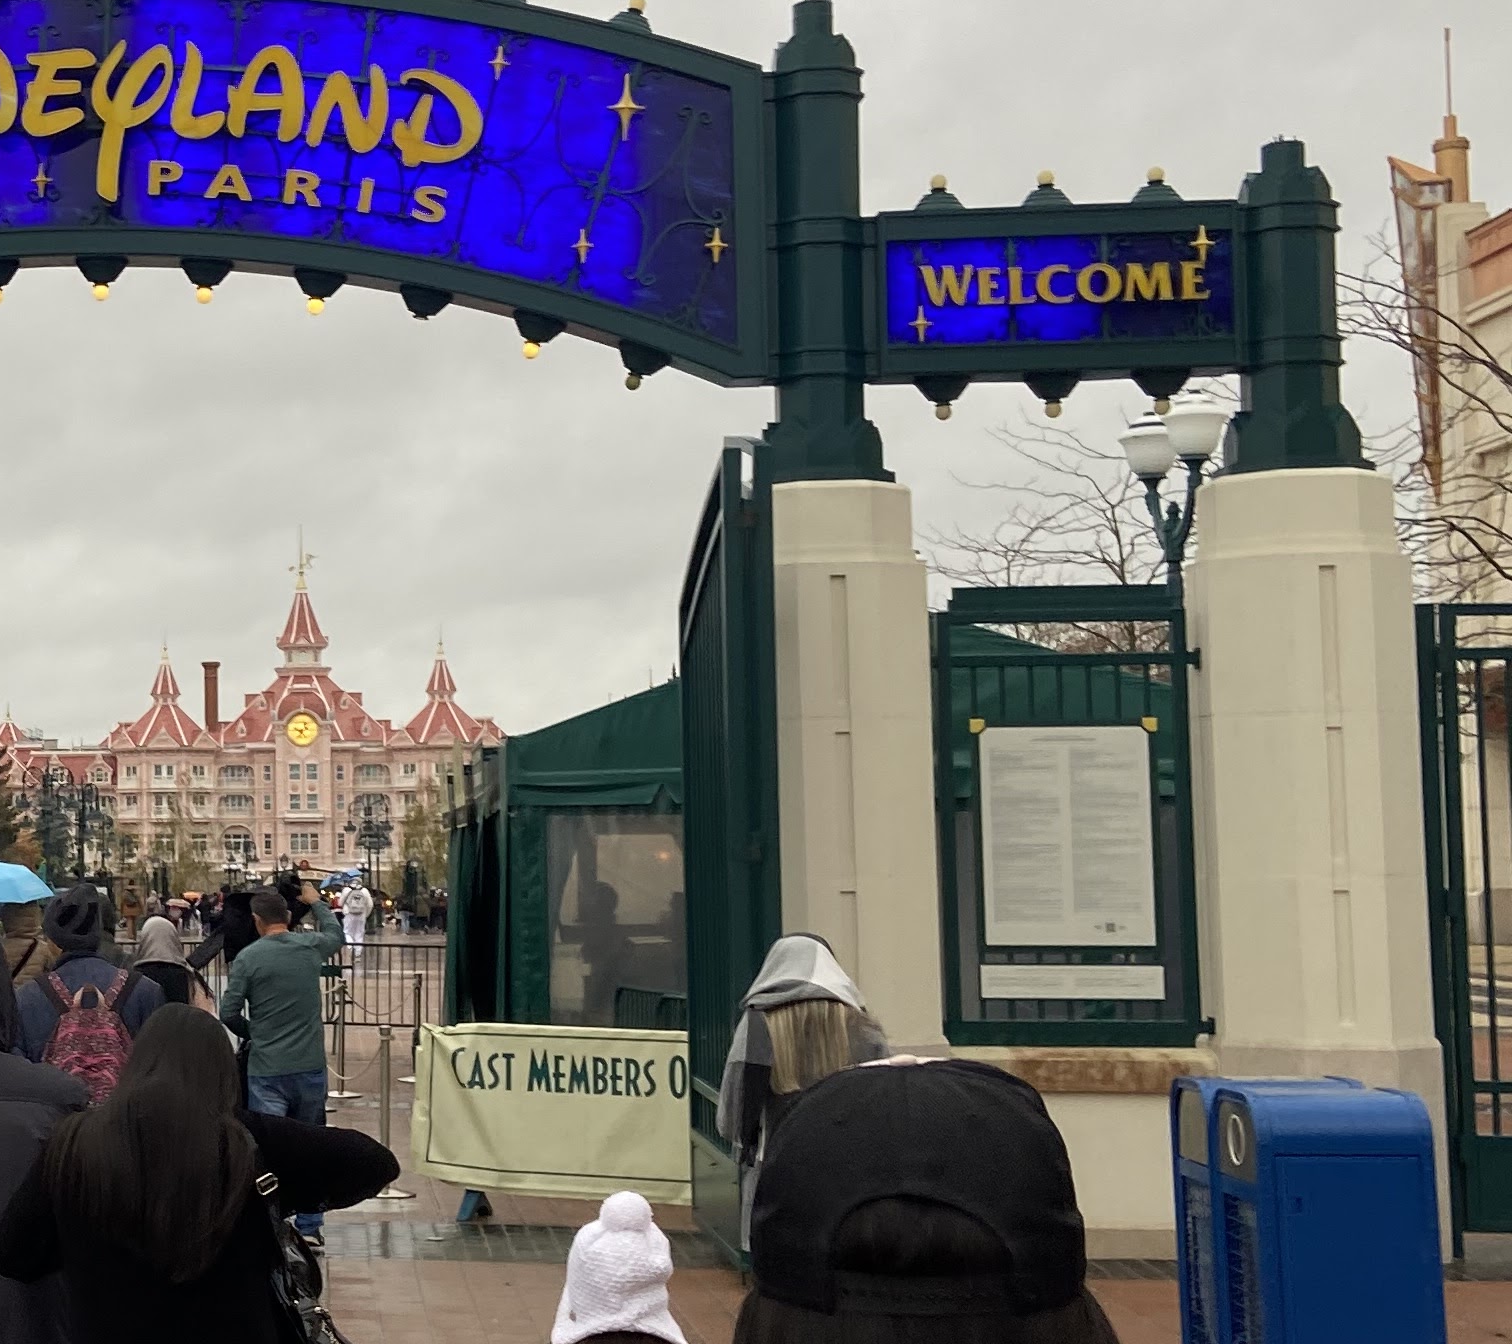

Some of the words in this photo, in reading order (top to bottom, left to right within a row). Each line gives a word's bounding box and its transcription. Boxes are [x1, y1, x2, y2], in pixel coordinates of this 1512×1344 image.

[147, 160, 448, 223] PARIS
[919, 261, 1212, 307] WELCOME
[451, 1046, 516, 1090] CAST
[528, 1049, 657, 1097] MEMBERS
